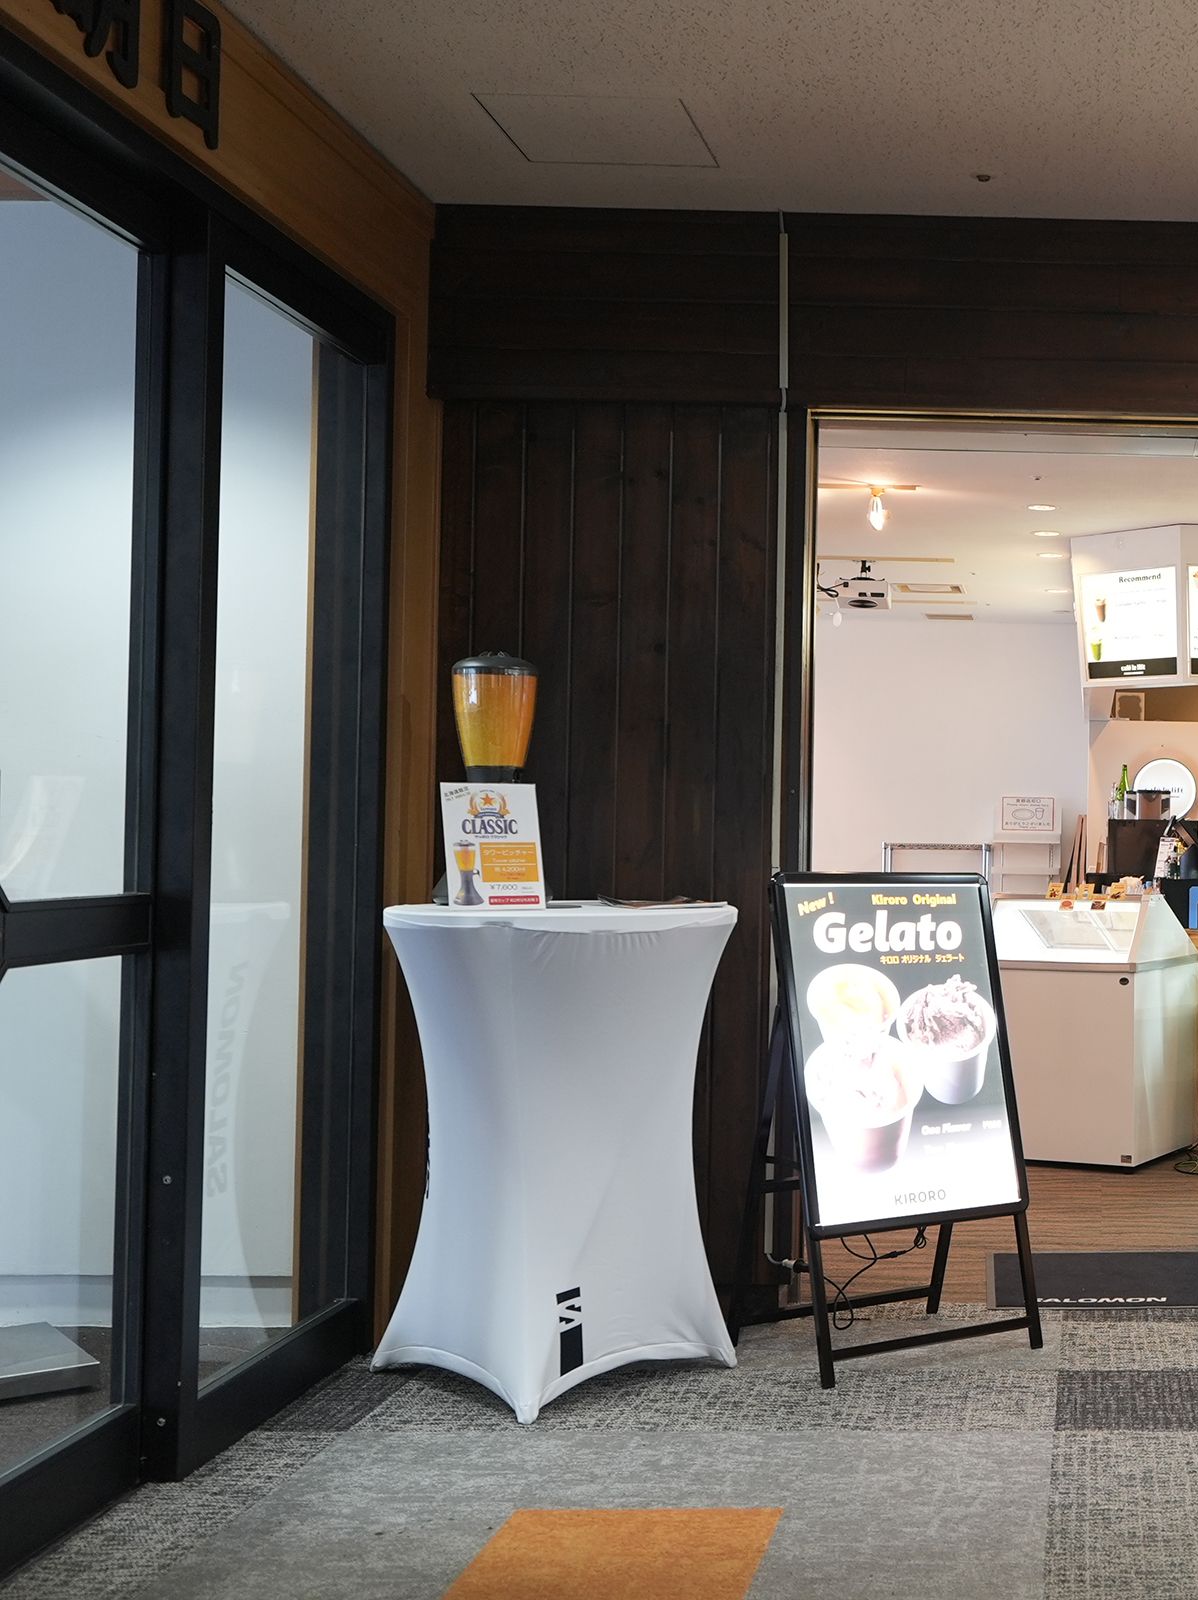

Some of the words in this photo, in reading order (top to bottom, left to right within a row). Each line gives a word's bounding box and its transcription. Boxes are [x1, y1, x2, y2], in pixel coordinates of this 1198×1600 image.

[1118, 574, 1161, 583] Recommend
[461, 819, 518, 835] CLASSIC
[872, 894, 908, 905] Kiroro
[912, 894, 956, 907] Original
[813, 910, 962, 954] Gelato
[880, 955, 899, 964] キロロ
[901, 954, 931, 964] オリジナル
[935, 953, 964, 963] ジェラート
[894, 1189, 946, 1206] KIRORO
